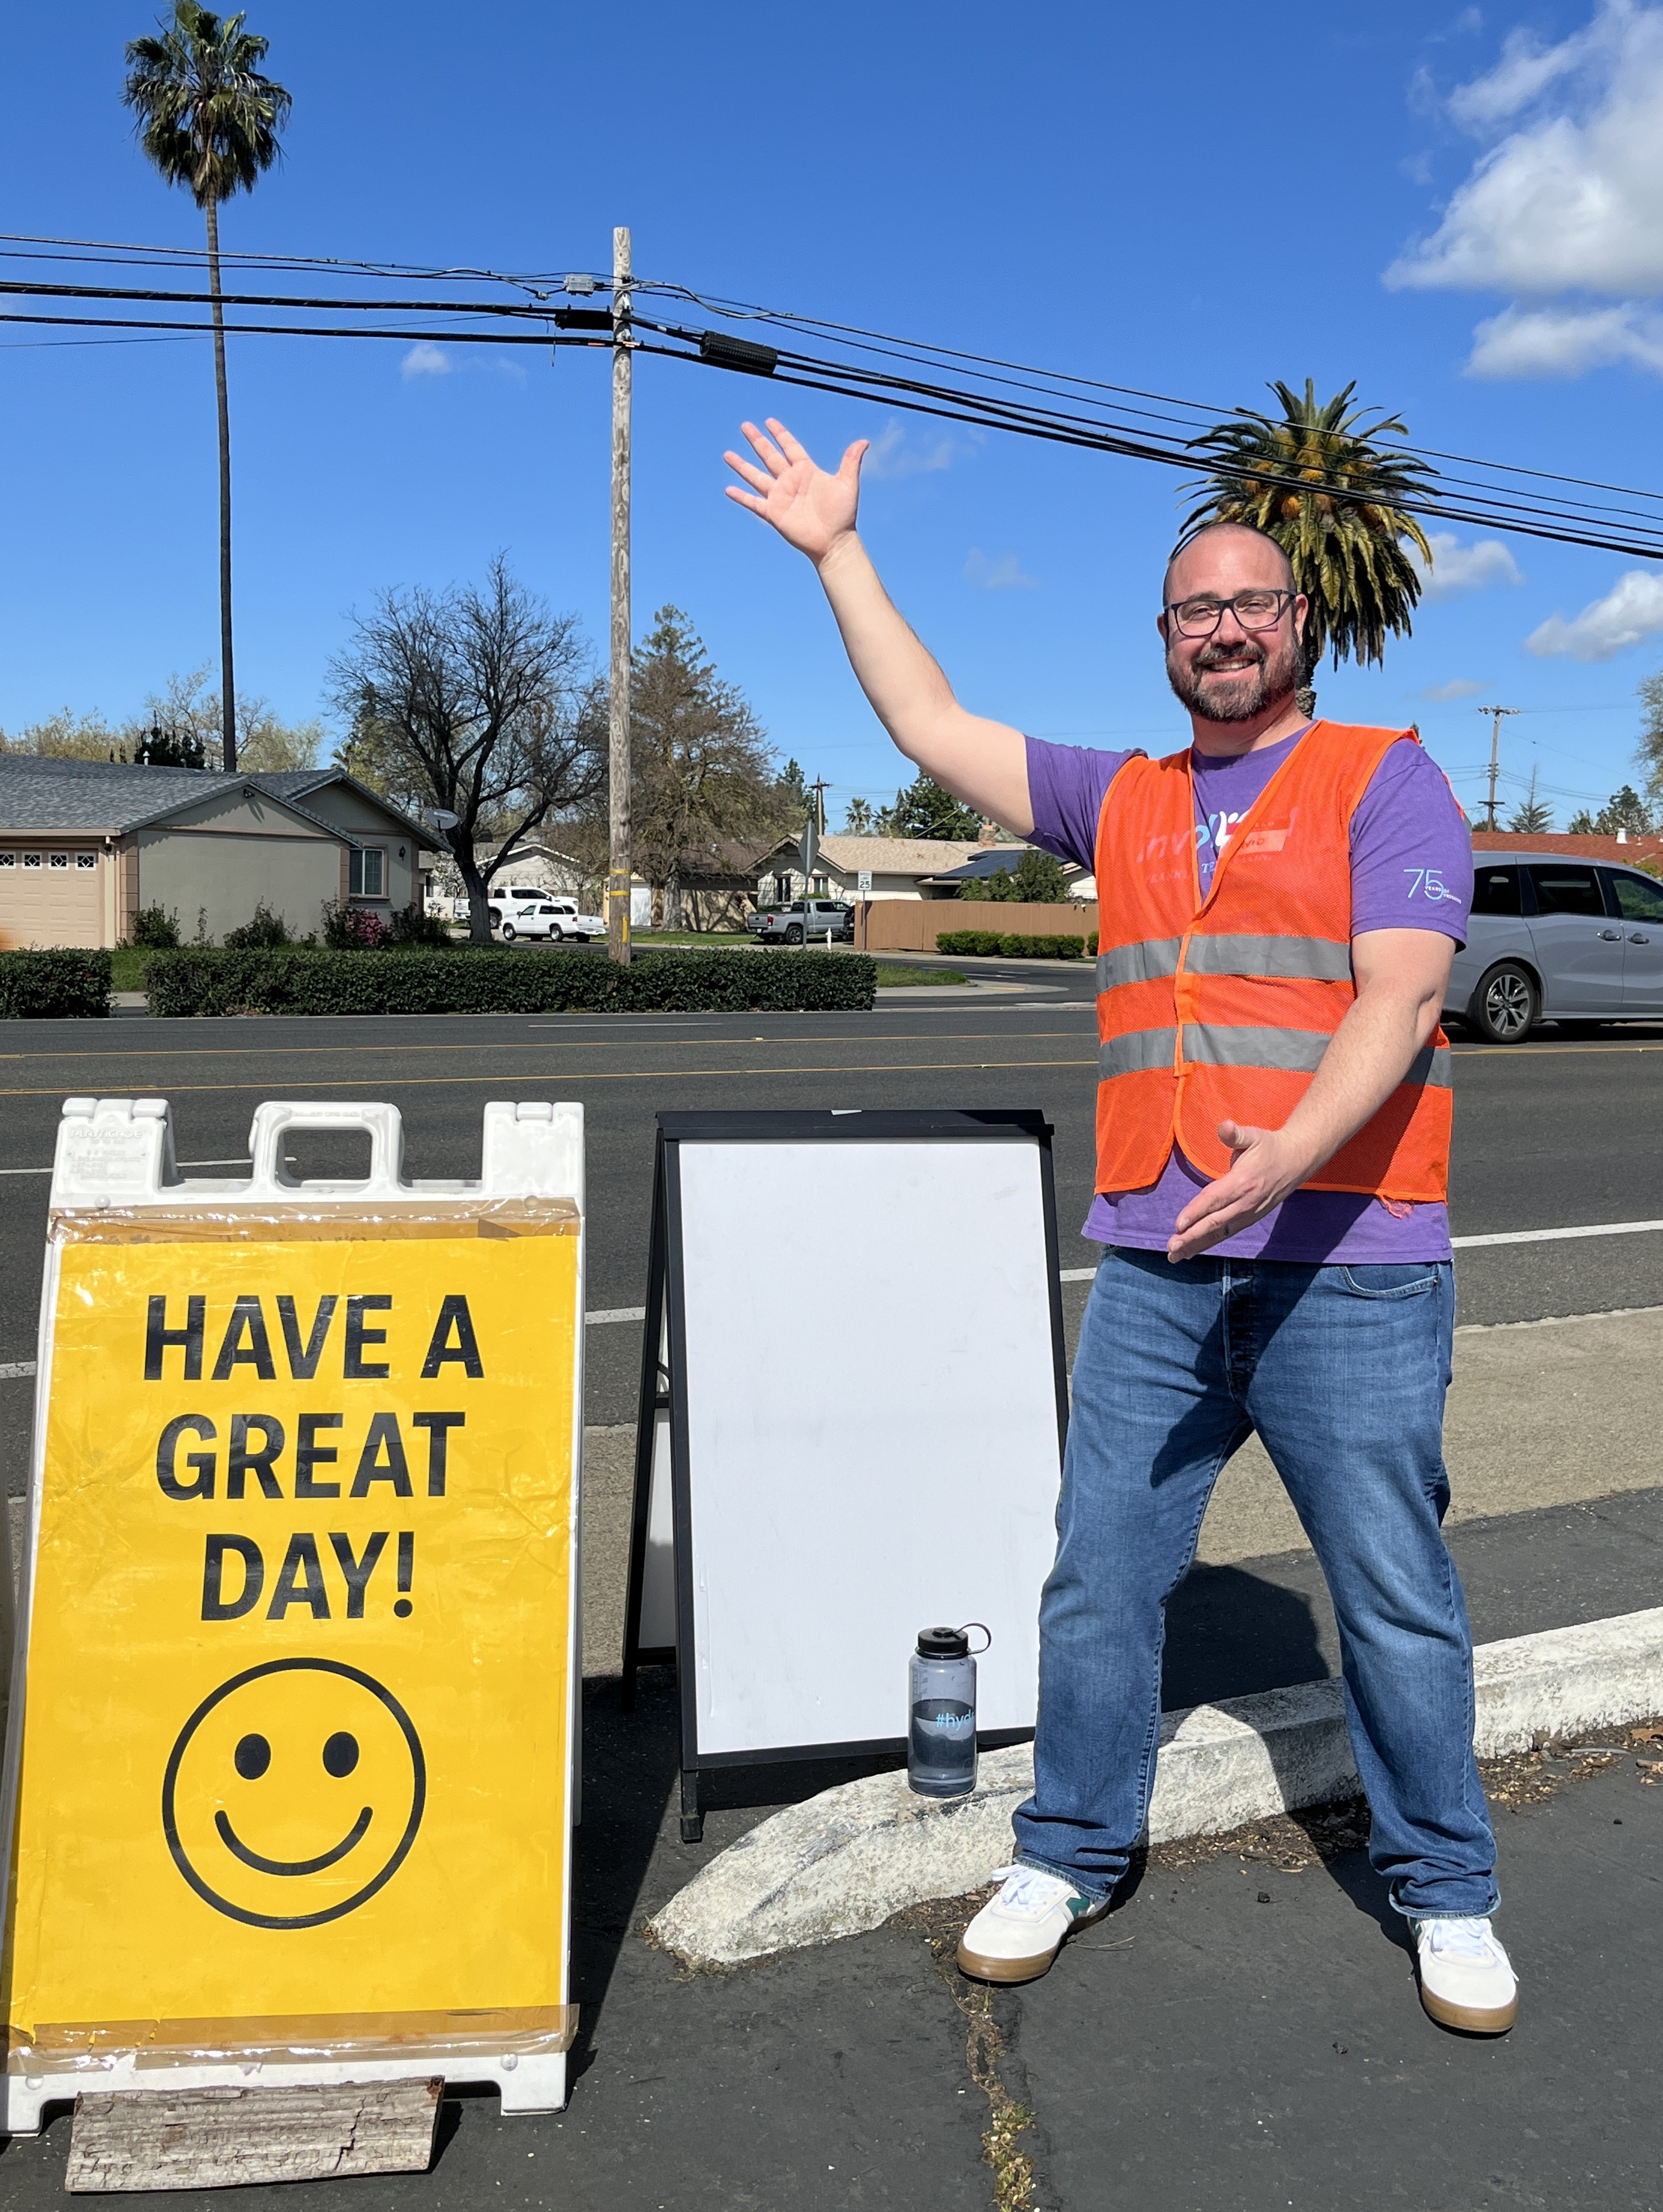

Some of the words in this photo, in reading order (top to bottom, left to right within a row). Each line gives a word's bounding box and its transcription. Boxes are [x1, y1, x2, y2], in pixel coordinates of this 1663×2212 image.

[1403, 869, 1443, 900] 75
[144, 1295, 391, 1380] HAVE
[421, 1295, 484, 1378] A
[157, 1412, 465, 1500] GREAT
[201, 1532, 414, 1621] DAY!
